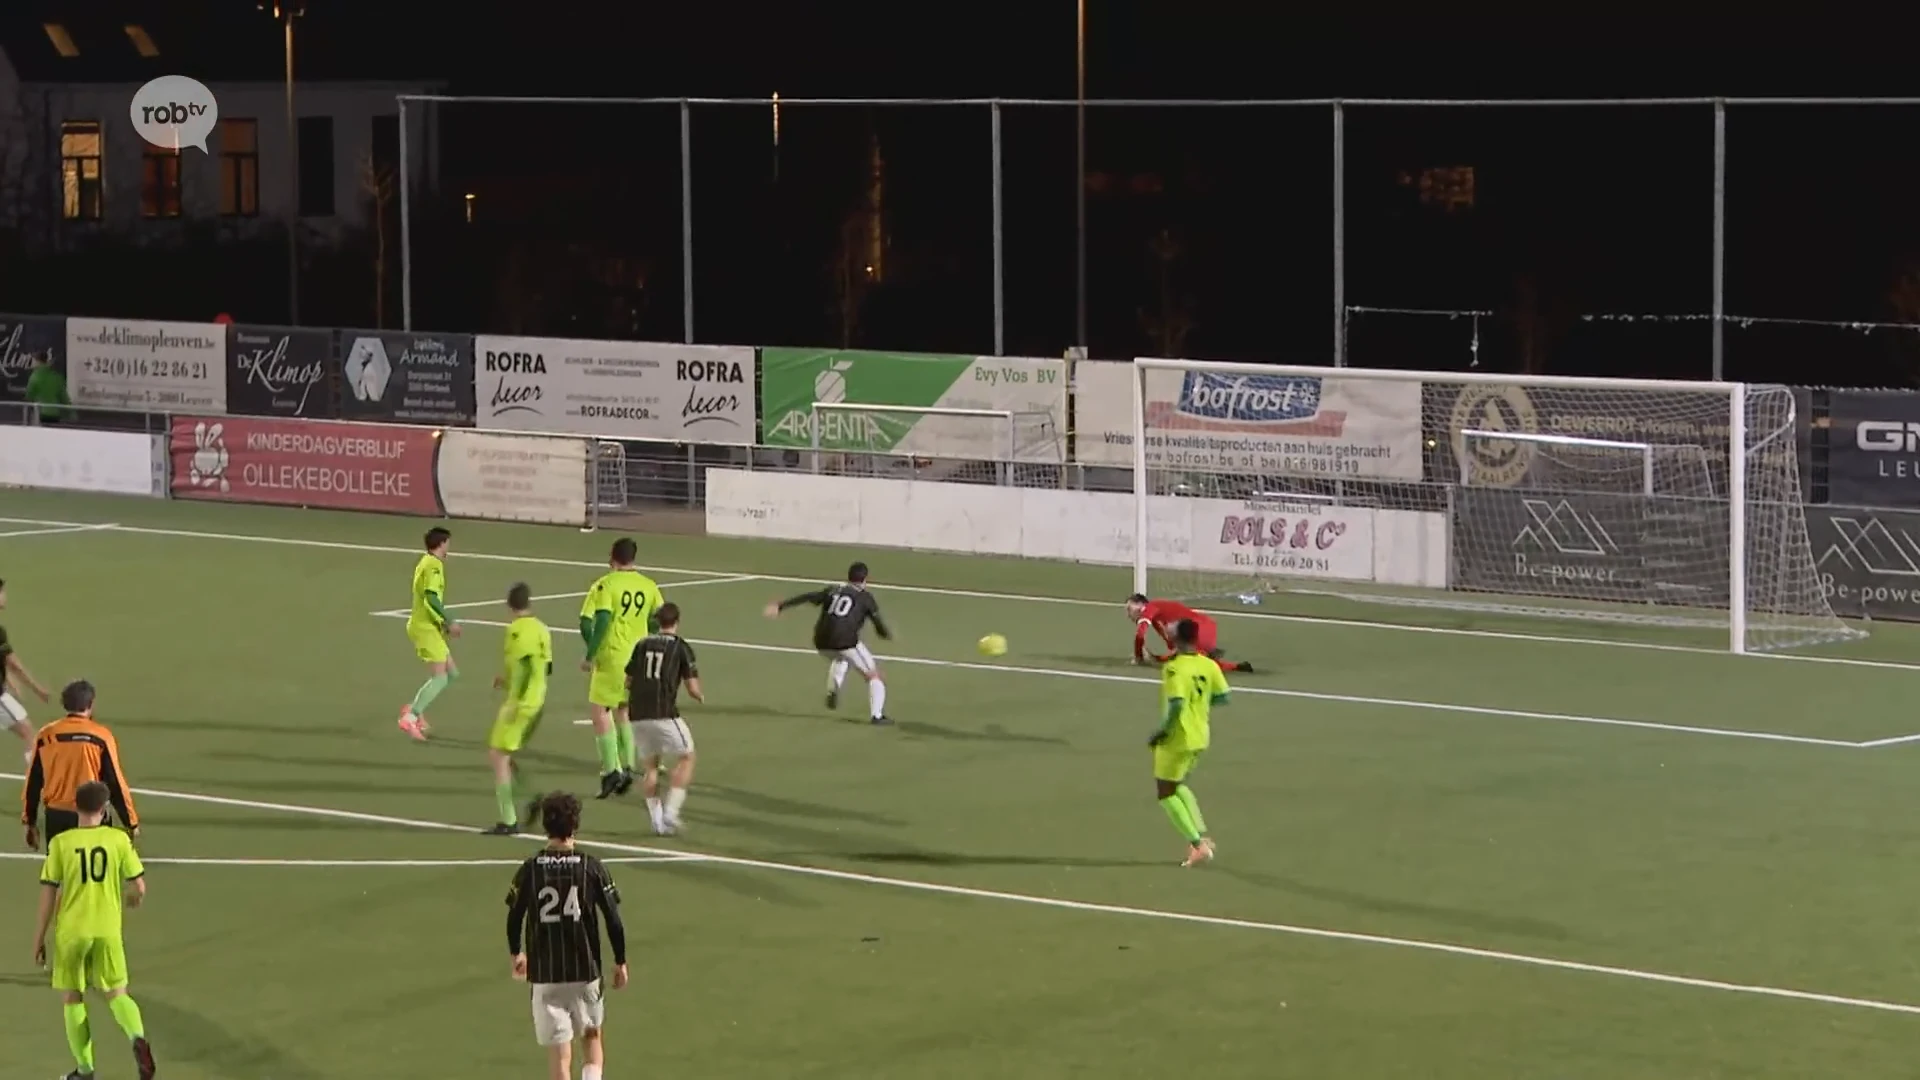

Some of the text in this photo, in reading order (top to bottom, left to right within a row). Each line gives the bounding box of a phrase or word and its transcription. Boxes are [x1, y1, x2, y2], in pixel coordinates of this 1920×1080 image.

[84, 356, 208, 379] +32(0)16 22 86 21
[400, 348, 460, 367] Armand
[486, 351, 547, 374] ROFRA
[677, 360, 744, 383] ROFRA
[247, 335, 325, 415] Klimop
[975, 366, 1056, 387] Evy Vos BV
[491, 375, 544, 407] decor
[681, 385, 741, 418] decor
[1192, 376, 1295, 420] bofrost
[768, 410, 892, 444] ARGENTA
[247, 432, 406, 459] KINDERDAGVERBLIJF
[1284, 444, 1305, 454] aan
[1308, 442, 1333, 455] huis
[1336, 444, 1391, 459] gebracht
[243, 463, 411, 497] OLLEKEBOLLEKE
[1220, 515, 1287, 549] BOLS
[1290, 518, 1310, 549] &
[1256, 555, 1278, 568] 016
[1280, 556, 1296, 569] 60
[1299, 557, 1314, 570] 20
[1515, 554, 1616, 586] Be-power
[621, 591, 645, 617] 99
[828, 594, 853, 617] 10
[645, 651, 664, 679] 11
[75, 846, 107, 884] 10
[538, 885, 582, 923] 24
